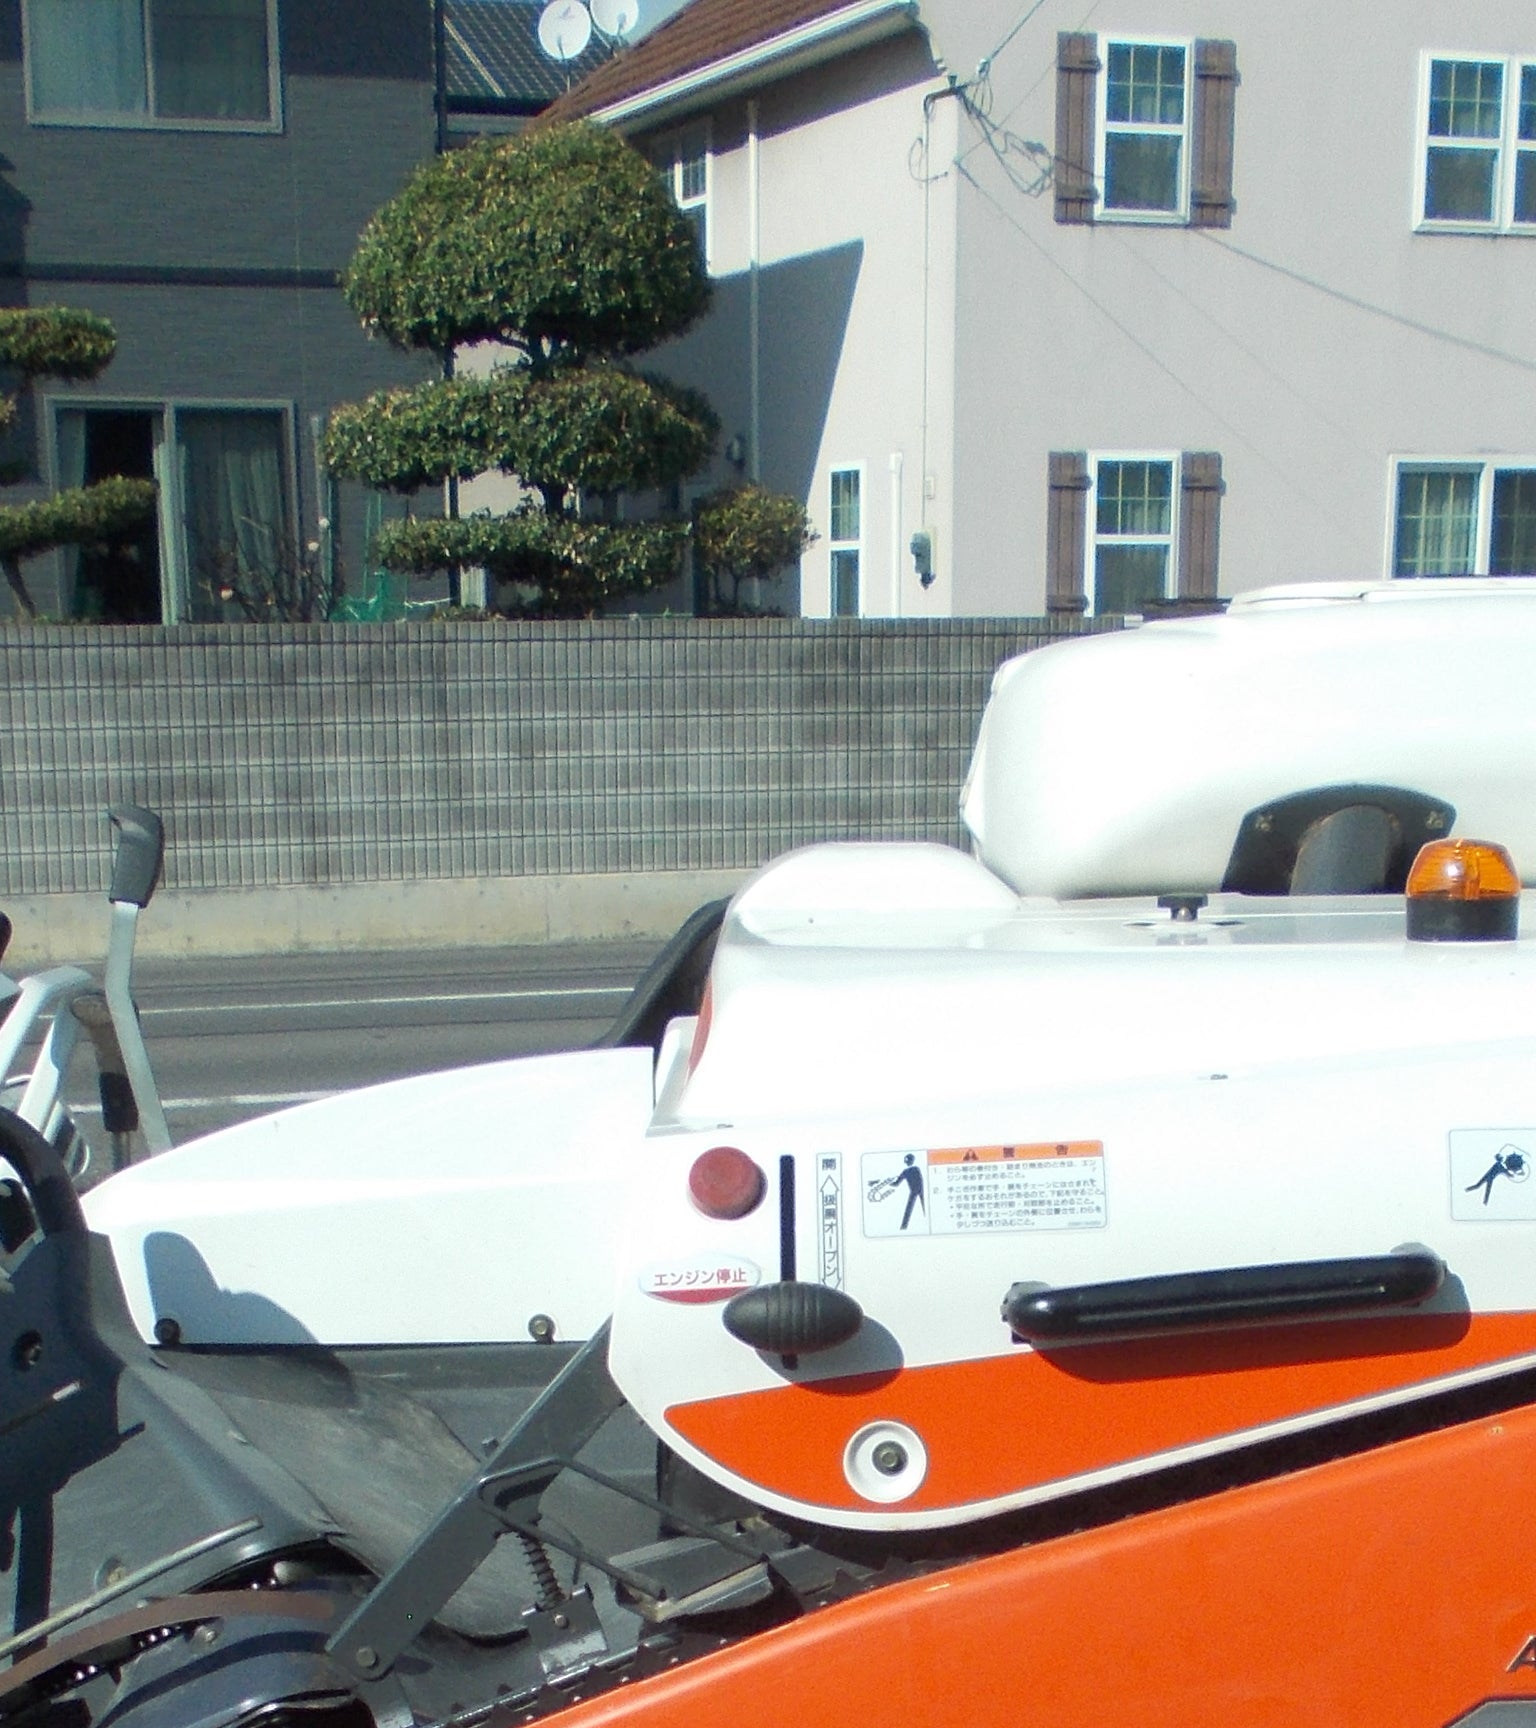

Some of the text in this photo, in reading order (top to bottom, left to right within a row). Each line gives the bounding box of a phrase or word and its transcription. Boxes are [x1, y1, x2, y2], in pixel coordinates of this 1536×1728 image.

[654, 1267, 747, 1286] エンジン停止
